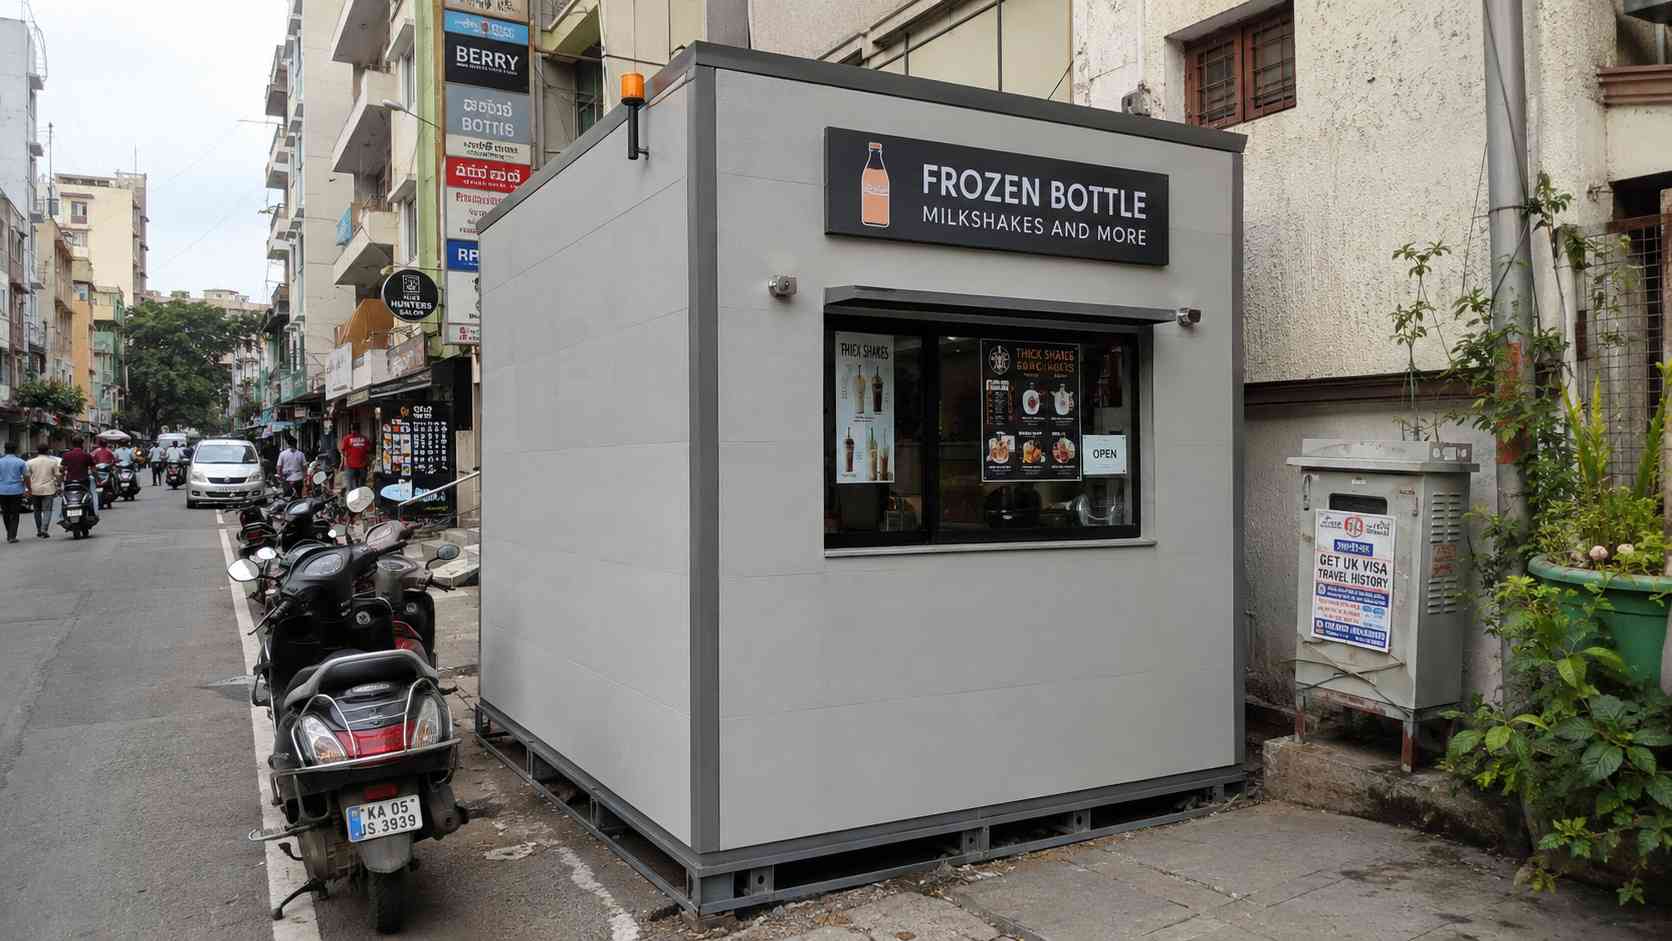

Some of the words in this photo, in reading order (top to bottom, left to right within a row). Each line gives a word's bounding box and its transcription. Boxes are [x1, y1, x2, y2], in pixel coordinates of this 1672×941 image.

[456, 45, 519, 71] BERRY
[922, 163, 1040, 207] FROZEN
[1050, 180, 1147, 219] BOTTLE
[922, 205, 1044, 234] MILKSHAKES
[1051, 220, 1090, 239] AND
[1097, 225, 1147, 246] MORE
[391, 300, 432, 310] HUNTERS
[1092, 448, 1117, 460] OPEN
[1319, 553, 1342, 567] GET
[1343, 558, 1359, 571] UK
[1362, 560, 1388, 575] VISA
[1318, 568, 1349, 583] TRAVEL
[1350, 572, 1389, 588] HISTORY
[367, 805, 387, 820] KA
[391, 800, 409, 815] 05
